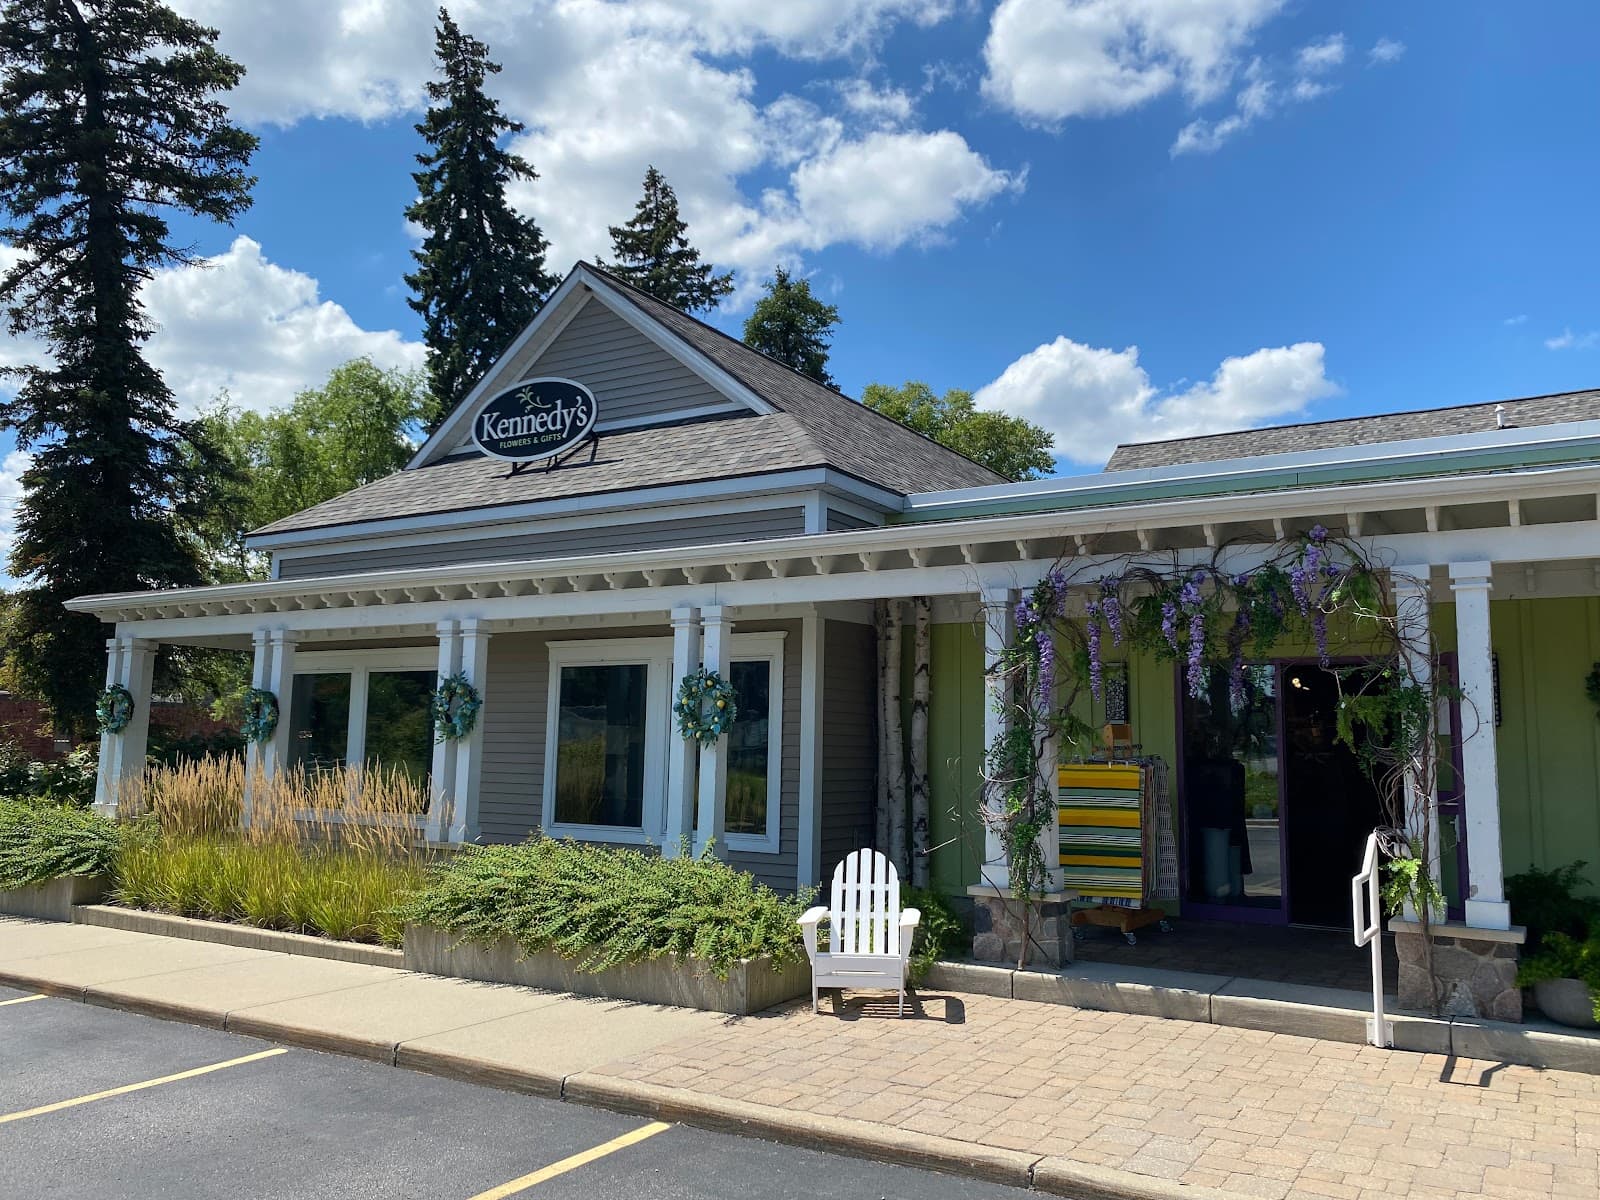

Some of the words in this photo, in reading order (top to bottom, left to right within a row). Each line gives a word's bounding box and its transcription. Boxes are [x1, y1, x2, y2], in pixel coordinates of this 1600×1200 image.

[481, 396, 587, 441] Kennedy's
[500, 437, 531, 449] FLOWERS
[541, 433, 561, 443] GIFTS
